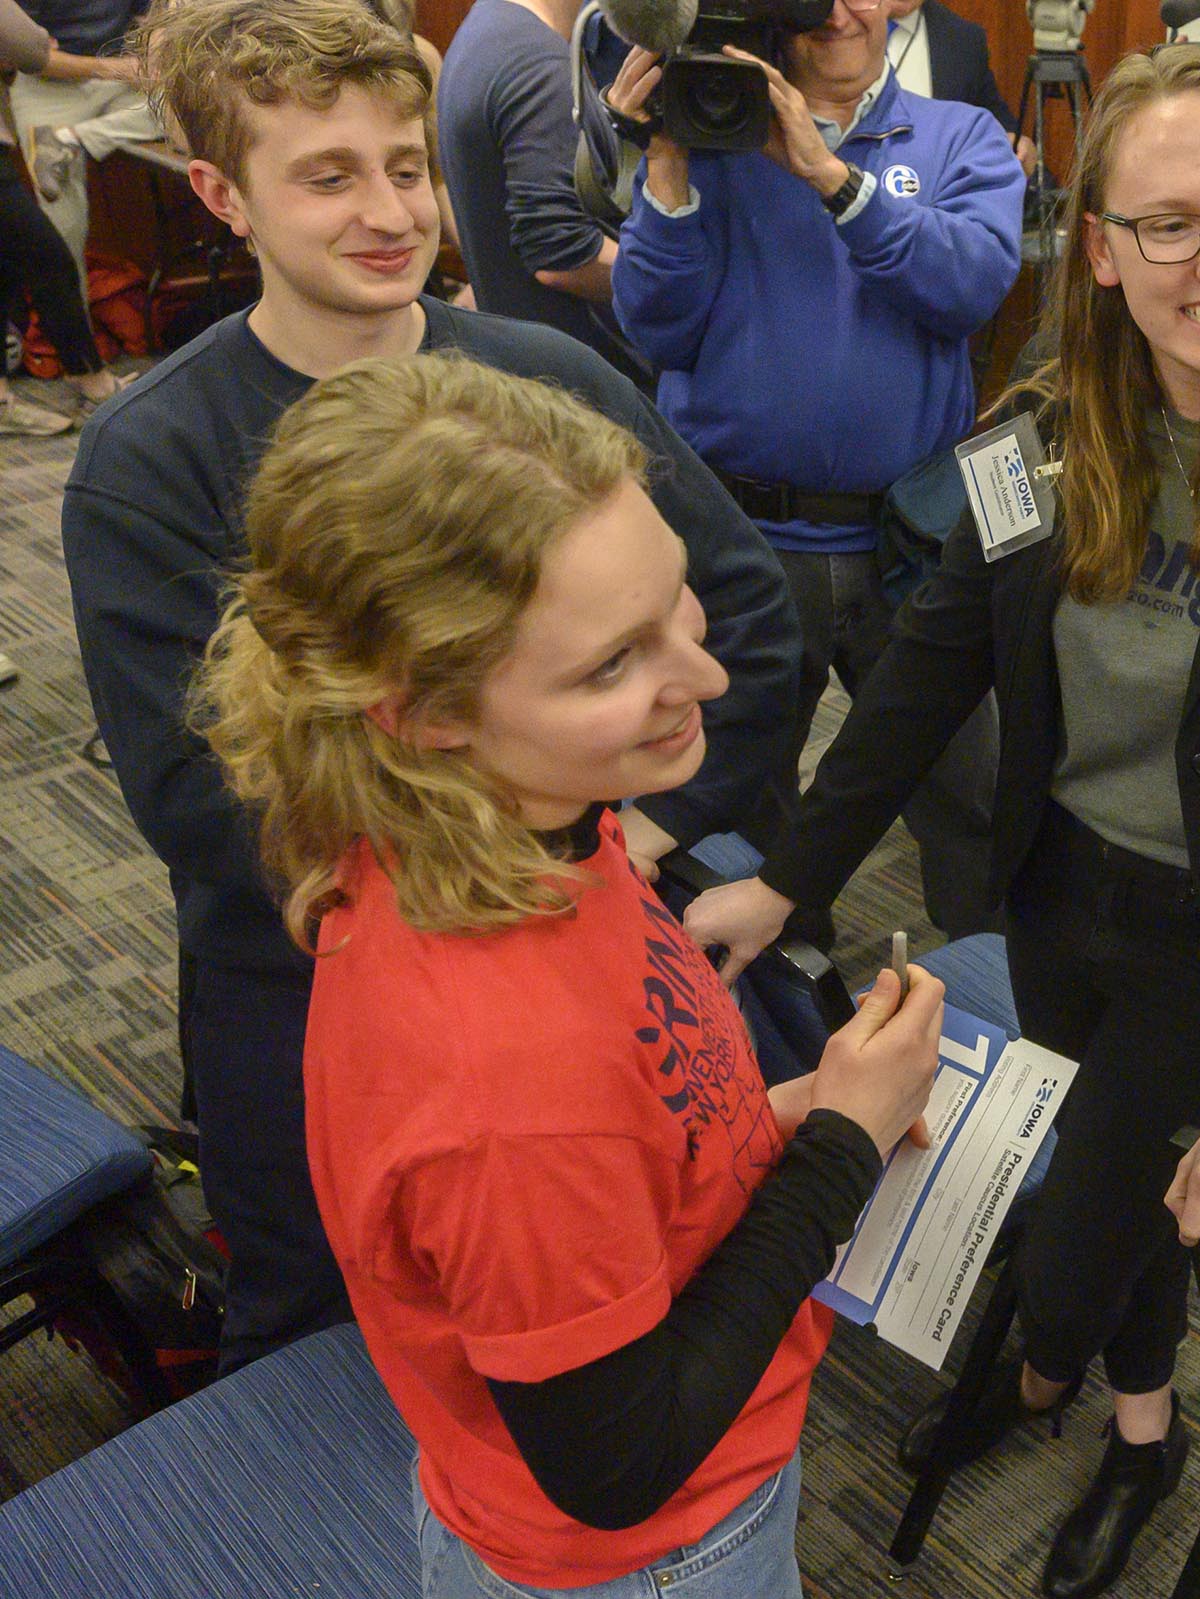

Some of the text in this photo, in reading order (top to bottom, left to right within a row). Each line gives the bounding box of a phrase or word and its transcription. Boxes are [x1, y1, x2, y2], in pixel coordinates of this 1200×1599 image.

[990, 454, 1016, 527] Jessica Anderson
[1016, 476, 1035, 517] IOWA
[959, 1081, 973, 1099] First
[935, 1099, 963, 1142] Preference:
[1019, 1102, 1044, 1140] IOWA
[990, 1148, 1011, 1181] Satellite
[975, 1180, 995, 1211] Caucus
[930, 1152, 1022, 1342] Presidential Preference Card
[906, 1260, 921, 1282] Iowa
